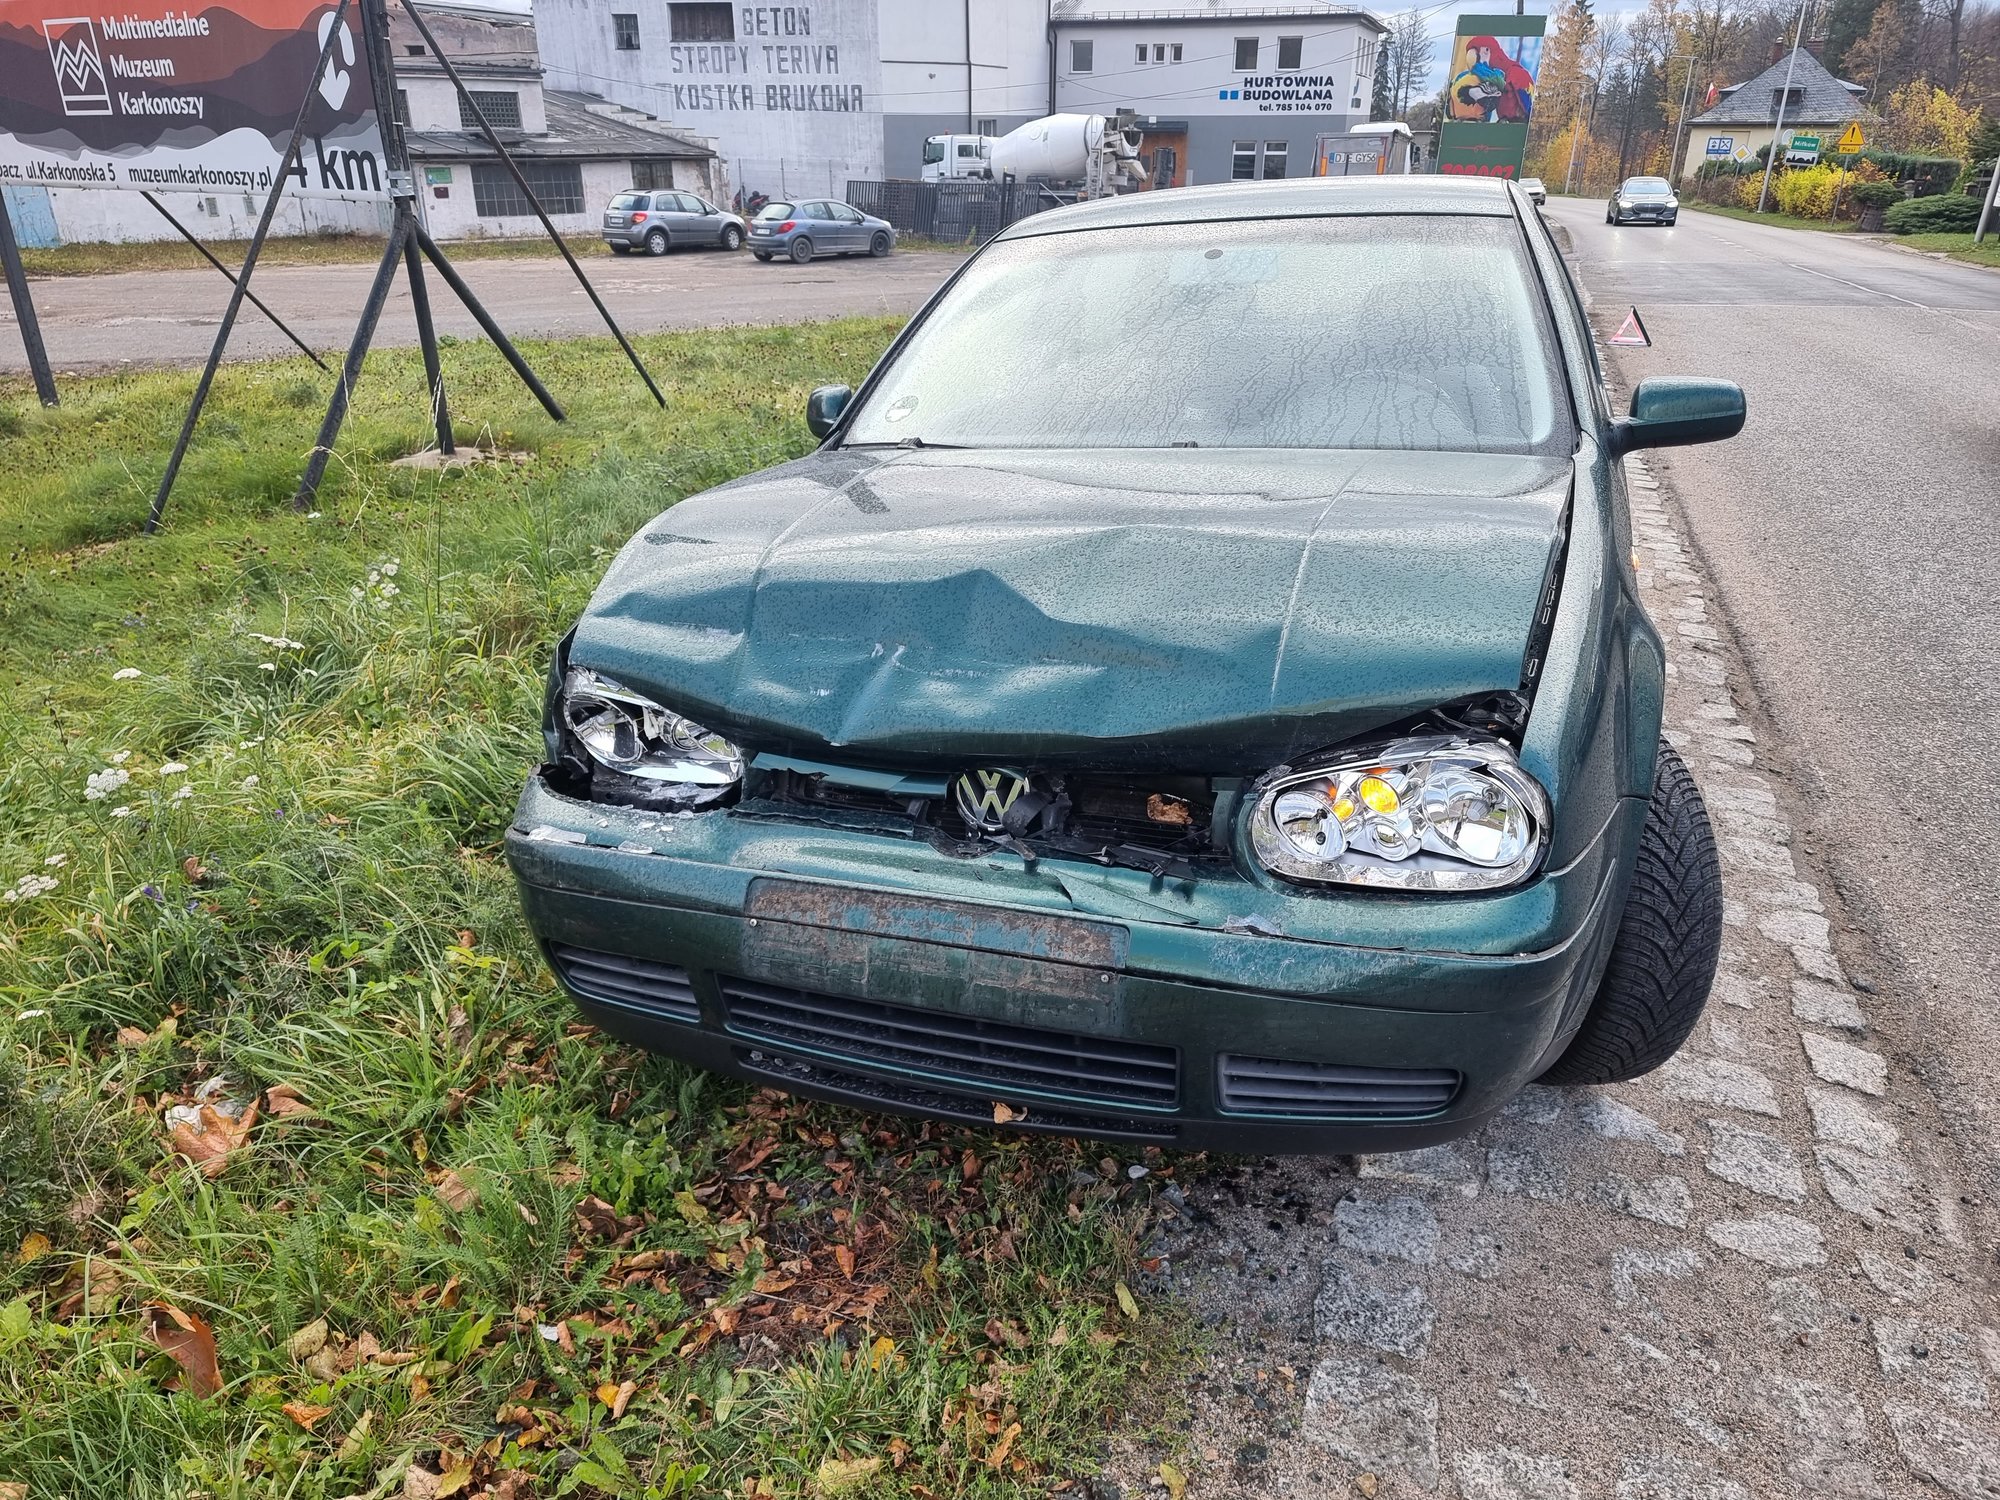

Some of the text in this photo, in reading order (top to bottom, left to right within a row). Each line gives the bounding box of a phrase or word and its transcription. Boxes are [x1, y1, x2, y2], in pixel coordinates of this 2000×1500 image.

[100, 11, 210, 41] Multimedialne
[742, 7, 810, 36] BETON
[110, 54, 175, 79] Muzeum
[670, 45, 839, 74] STROPY TERIVA
[1243, 76, 1334, 88] HURTOWNIA
[1243, 90, 1333, 101] BUDOWLANA
[118, 91, 204, 119] Karkonoszy
[674, 84, 864, 112] KOSTKA BRUKOWA
[1259, 103, 1332, 112] tel. 785 104 070
[0, 163, 23, 181] acz,
[107, 162, 116, 182] 5
[314, 134, 382, 191] km
[128, 164, 273, 190] muzeumkarkonoszy.pl
